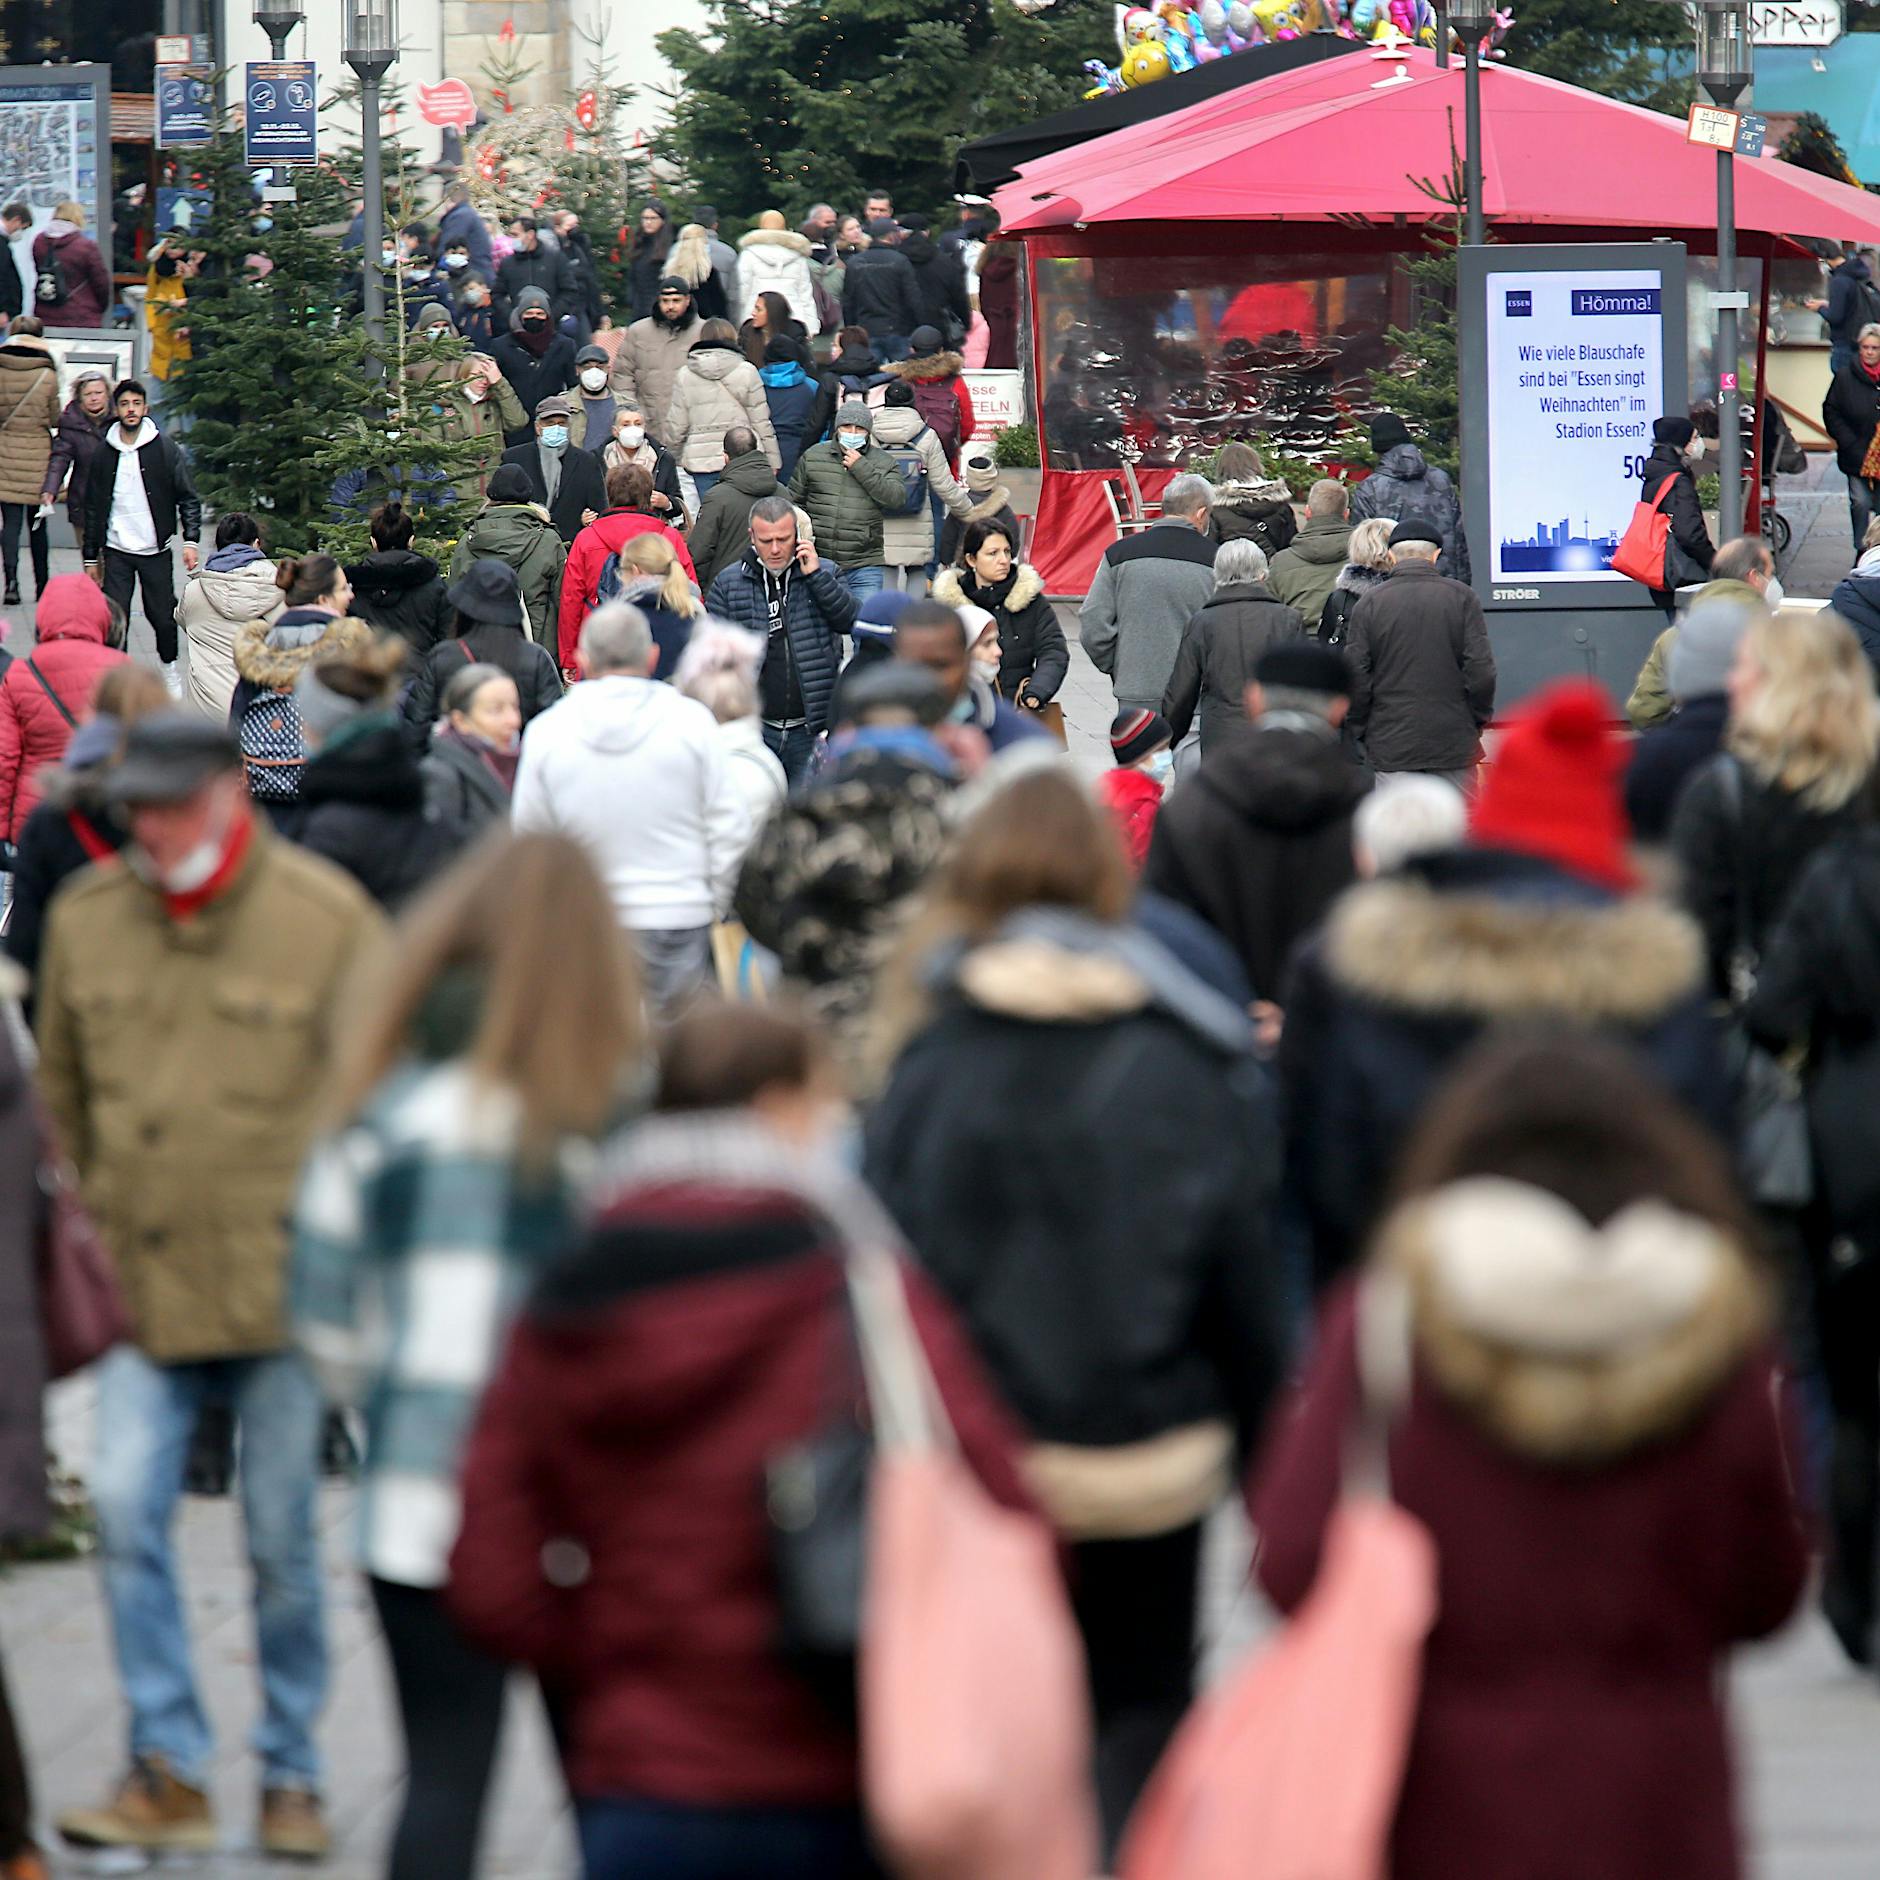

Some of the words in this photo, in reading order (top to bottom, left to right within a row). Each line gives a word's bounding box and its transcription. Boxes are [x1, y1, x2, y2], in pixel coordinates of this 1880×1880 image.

[1580, 294, 1652, 311] Hömma!
[1518, 345, 1543, 361] Wie
[1546, 345, 1576, 361] viele
[1579, 344, 1645, 360] Blauschafe
[1519, 371, 1545, 387] sind
[1548, 371, 1568, 387] bei
[1571, 370, 1611, 386] "Essen
[1614, 369, 1645, 388] singt
[1540, 396, 1626, 412] Weihnachten"
[1630, 395, 1646, 411] im
[1556, 422, 1603, 438] Stadion
[1606, 421, 1646, 437] Essen?
[1492, 588, 1540, 600] STRÖER
